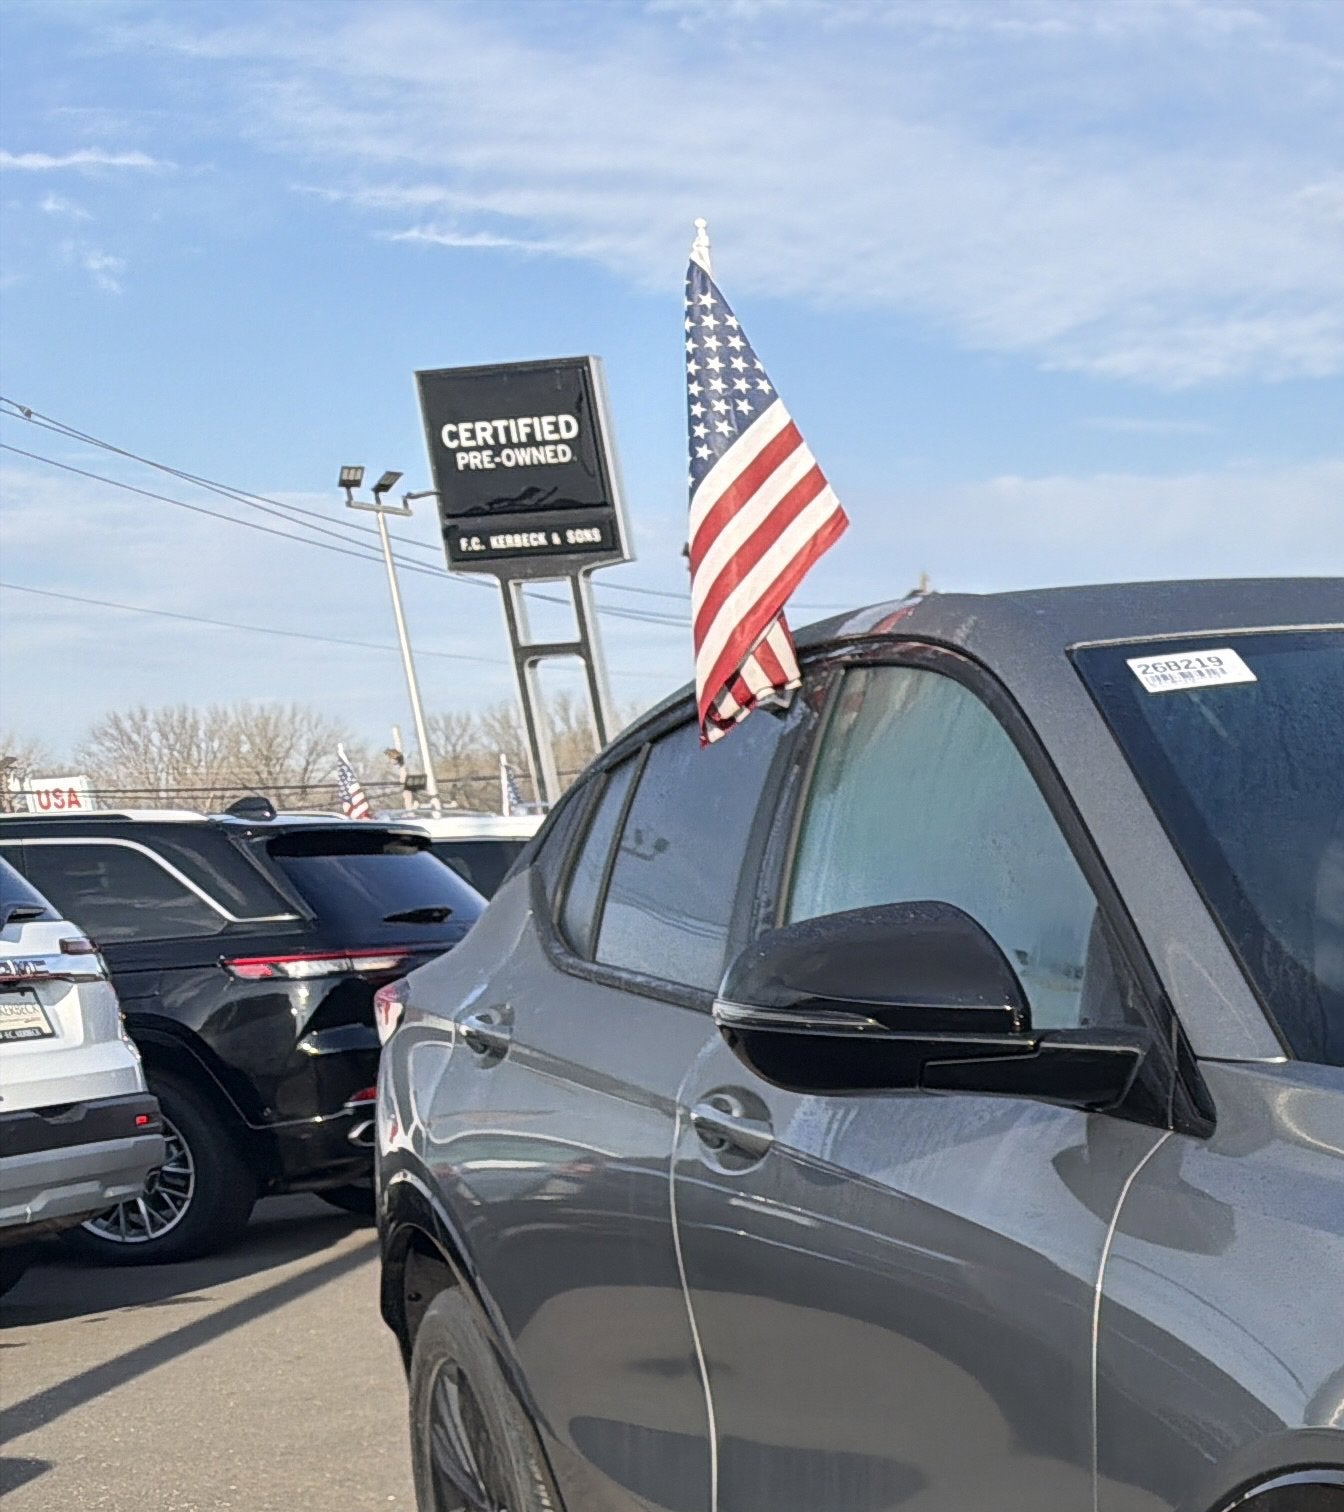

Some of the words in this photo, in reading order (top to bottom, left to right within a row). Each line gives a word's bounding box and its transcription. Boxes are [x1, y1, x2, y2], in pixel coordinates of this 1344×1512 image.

[441, 414, 579, 448] CERTIFIED
[456, 444, 572, 470] PRE-OWNED
[489, 531, 548, 549] KERBECK
[566, 527, 602, 545] SONS
[37, 788, 81, 810] USA
